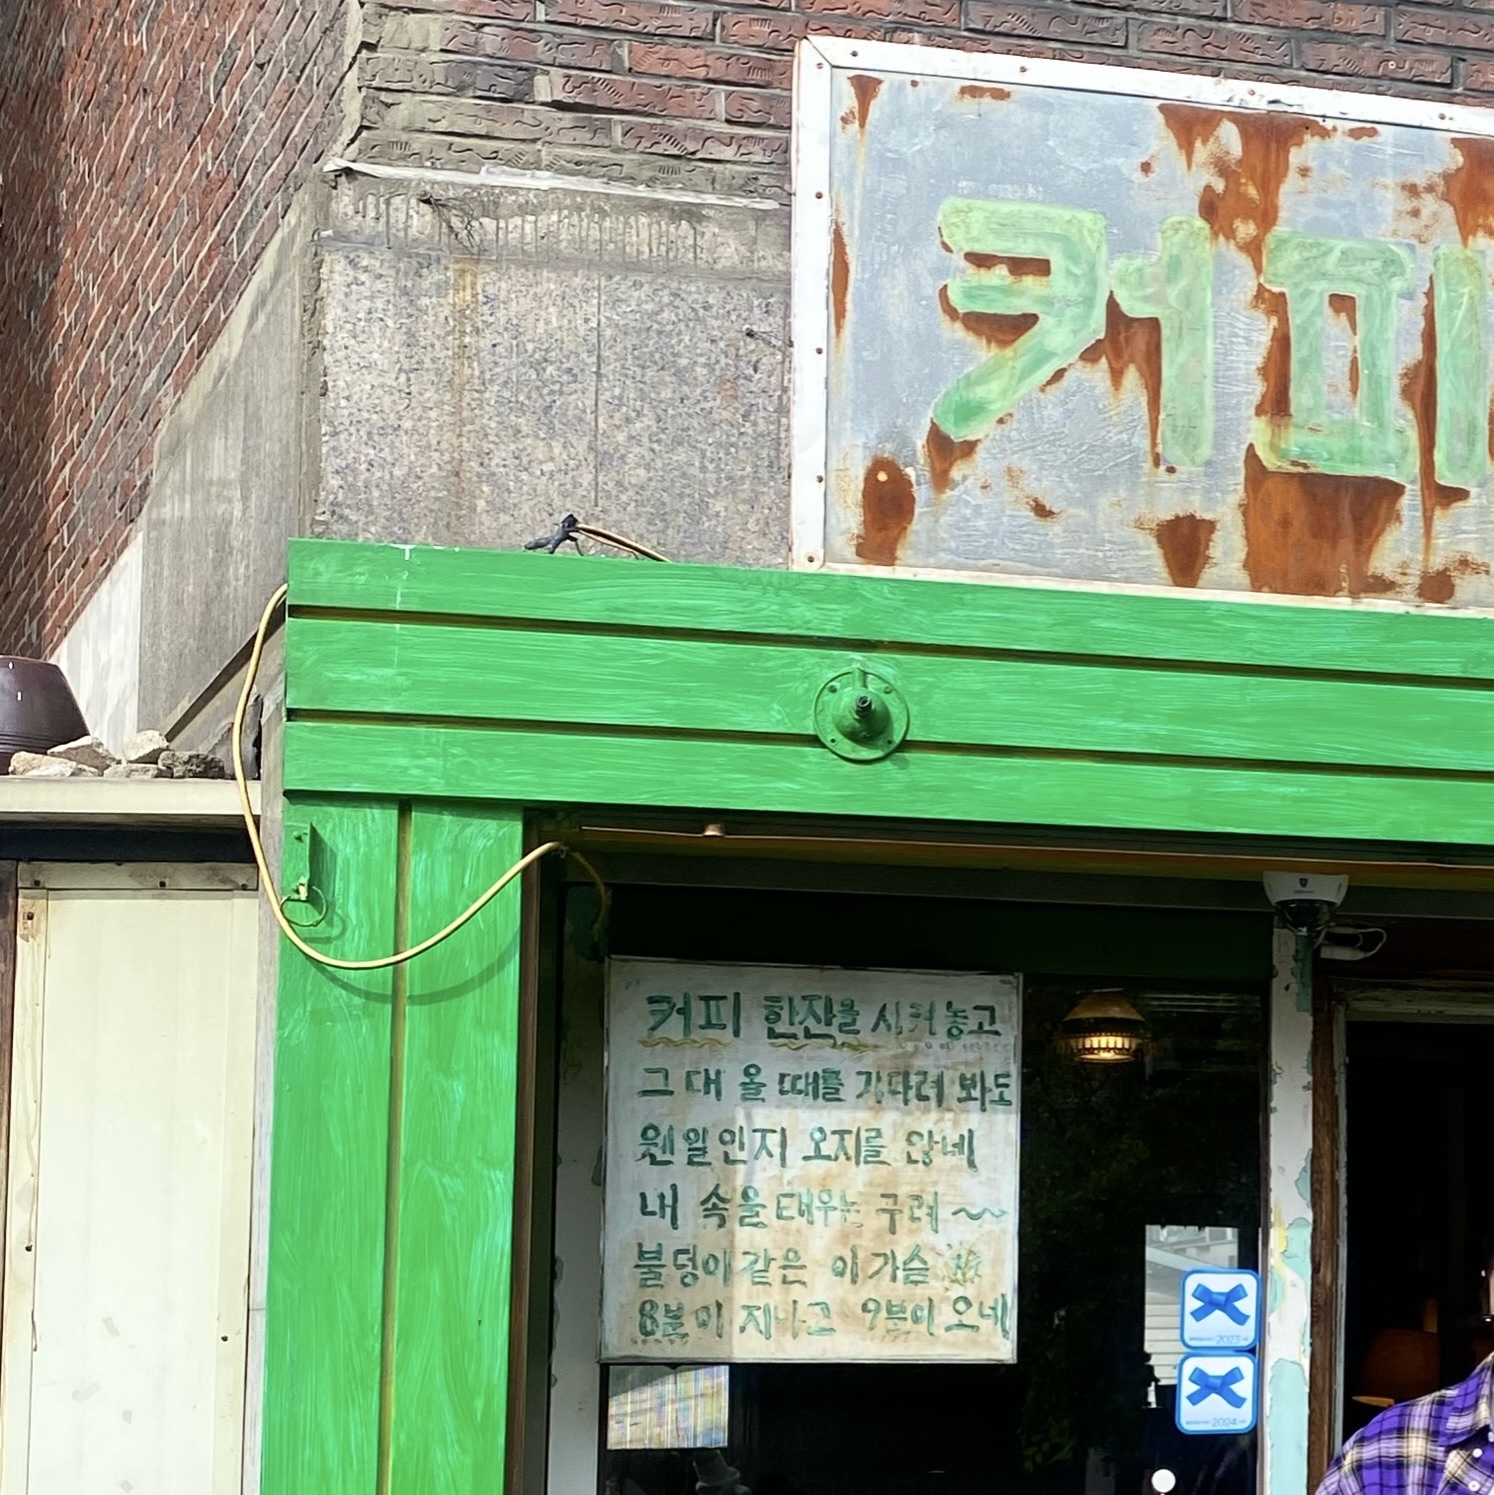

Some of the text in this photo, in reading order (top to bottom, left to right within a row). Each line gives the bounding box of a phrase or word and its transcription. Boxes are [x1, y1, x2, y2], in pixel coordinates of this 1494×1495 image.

[646, 992, 741, 1037] 커피
[763, 994, 860, 1043] 한잔을
[637, 1067, 722, 1102] 그대
[777, 1067, 845, 1103] 때를
[800, 1126, 892, 1167] 오지를
[905, 1128, 978, 1173] 않네
[638, 1184, 679, 1231] 내
[633, 1242, 732, 1289] 불덩이
[740, 1246, 808, 1289] 같은
[738, 1300, 837, 1341] 지나고
[944, 1293, 1010, 1341] 오네
